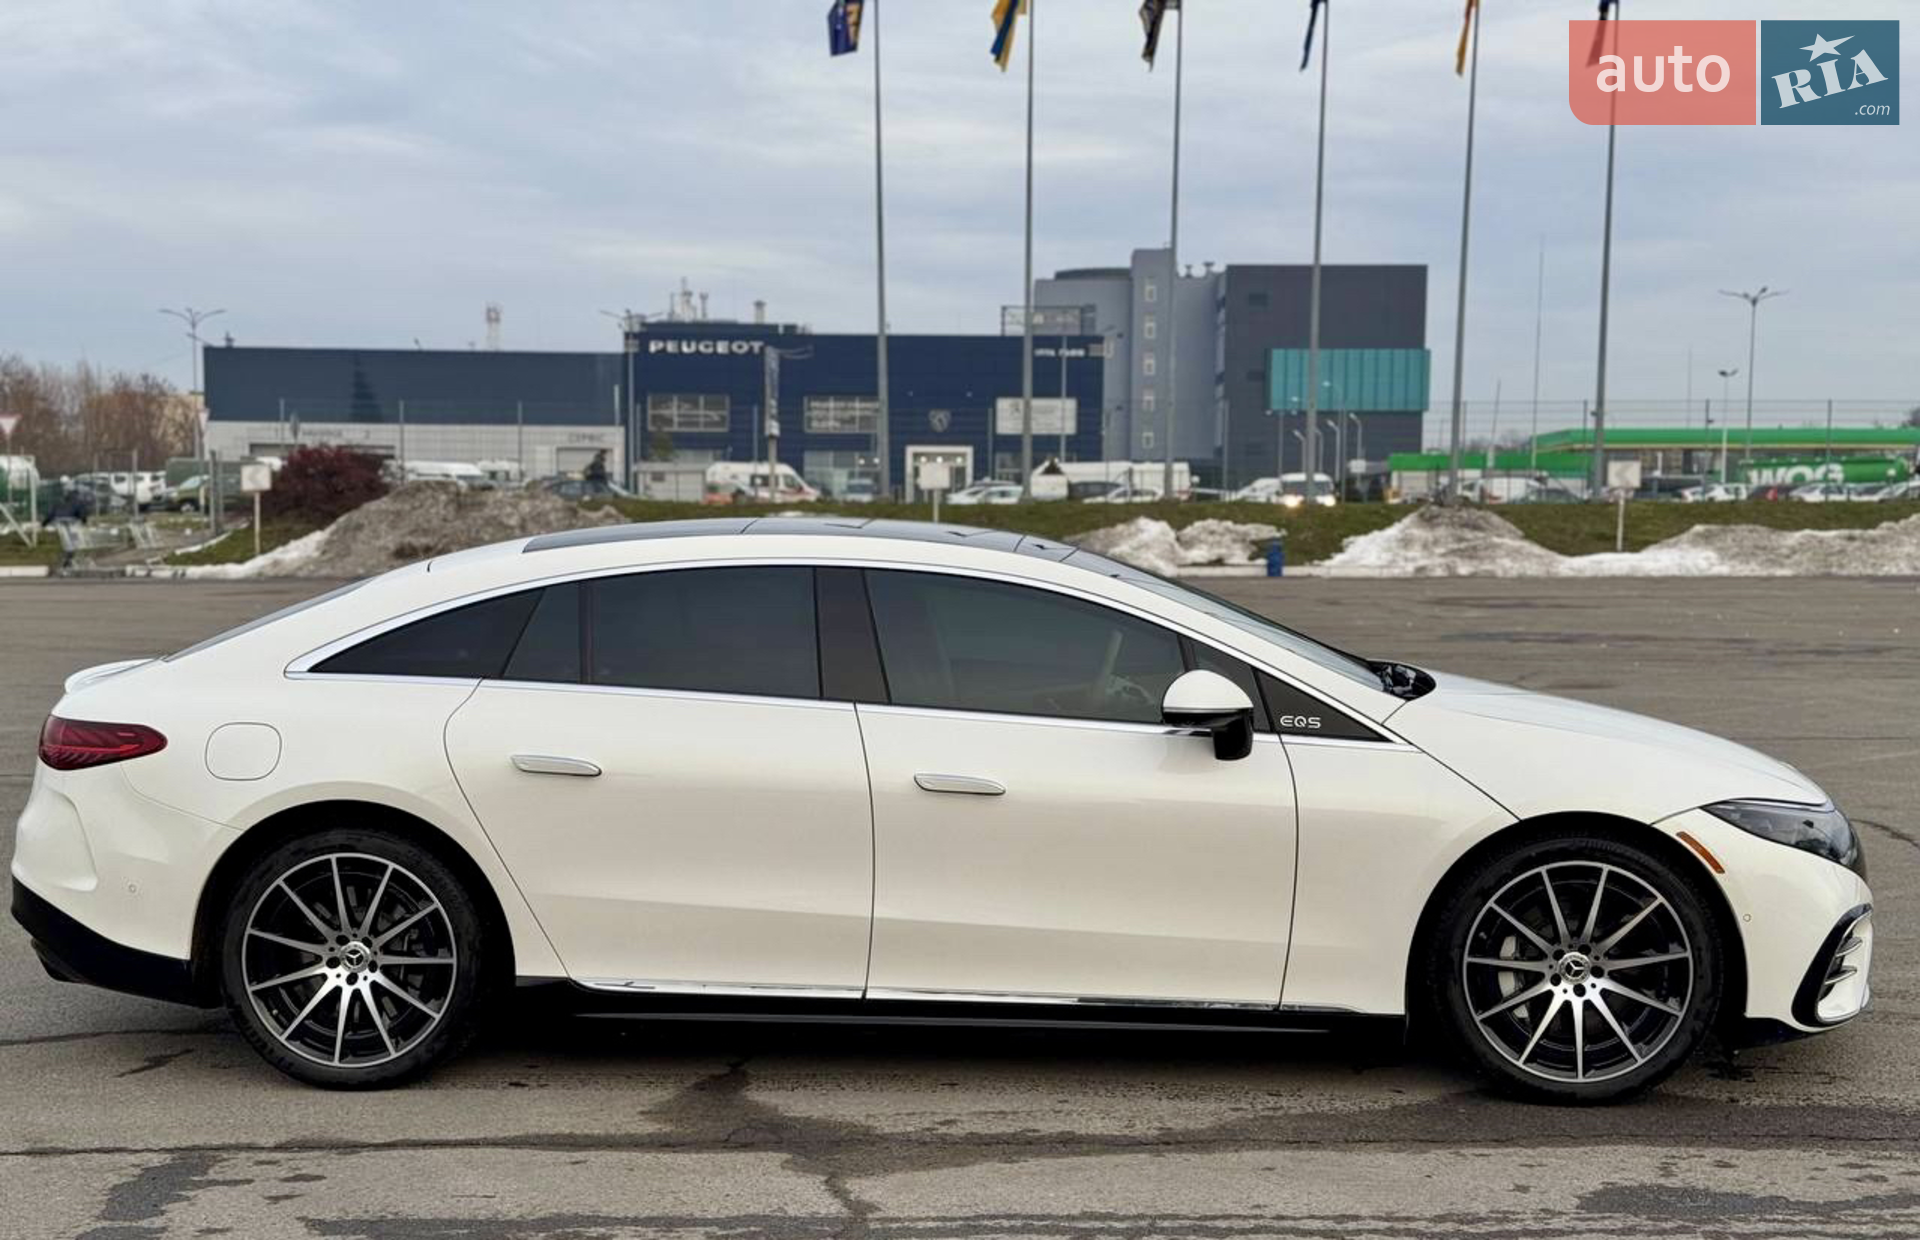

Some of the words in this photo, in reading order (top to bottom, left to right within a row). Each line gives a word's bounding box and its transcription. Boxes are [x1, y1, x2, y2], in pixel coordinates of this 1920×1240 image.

[648, 339, 764, 354] PEUGEOT
[1747, 463, 1845, 485] WOG
[1280, 715, 1321, 728] EQS
